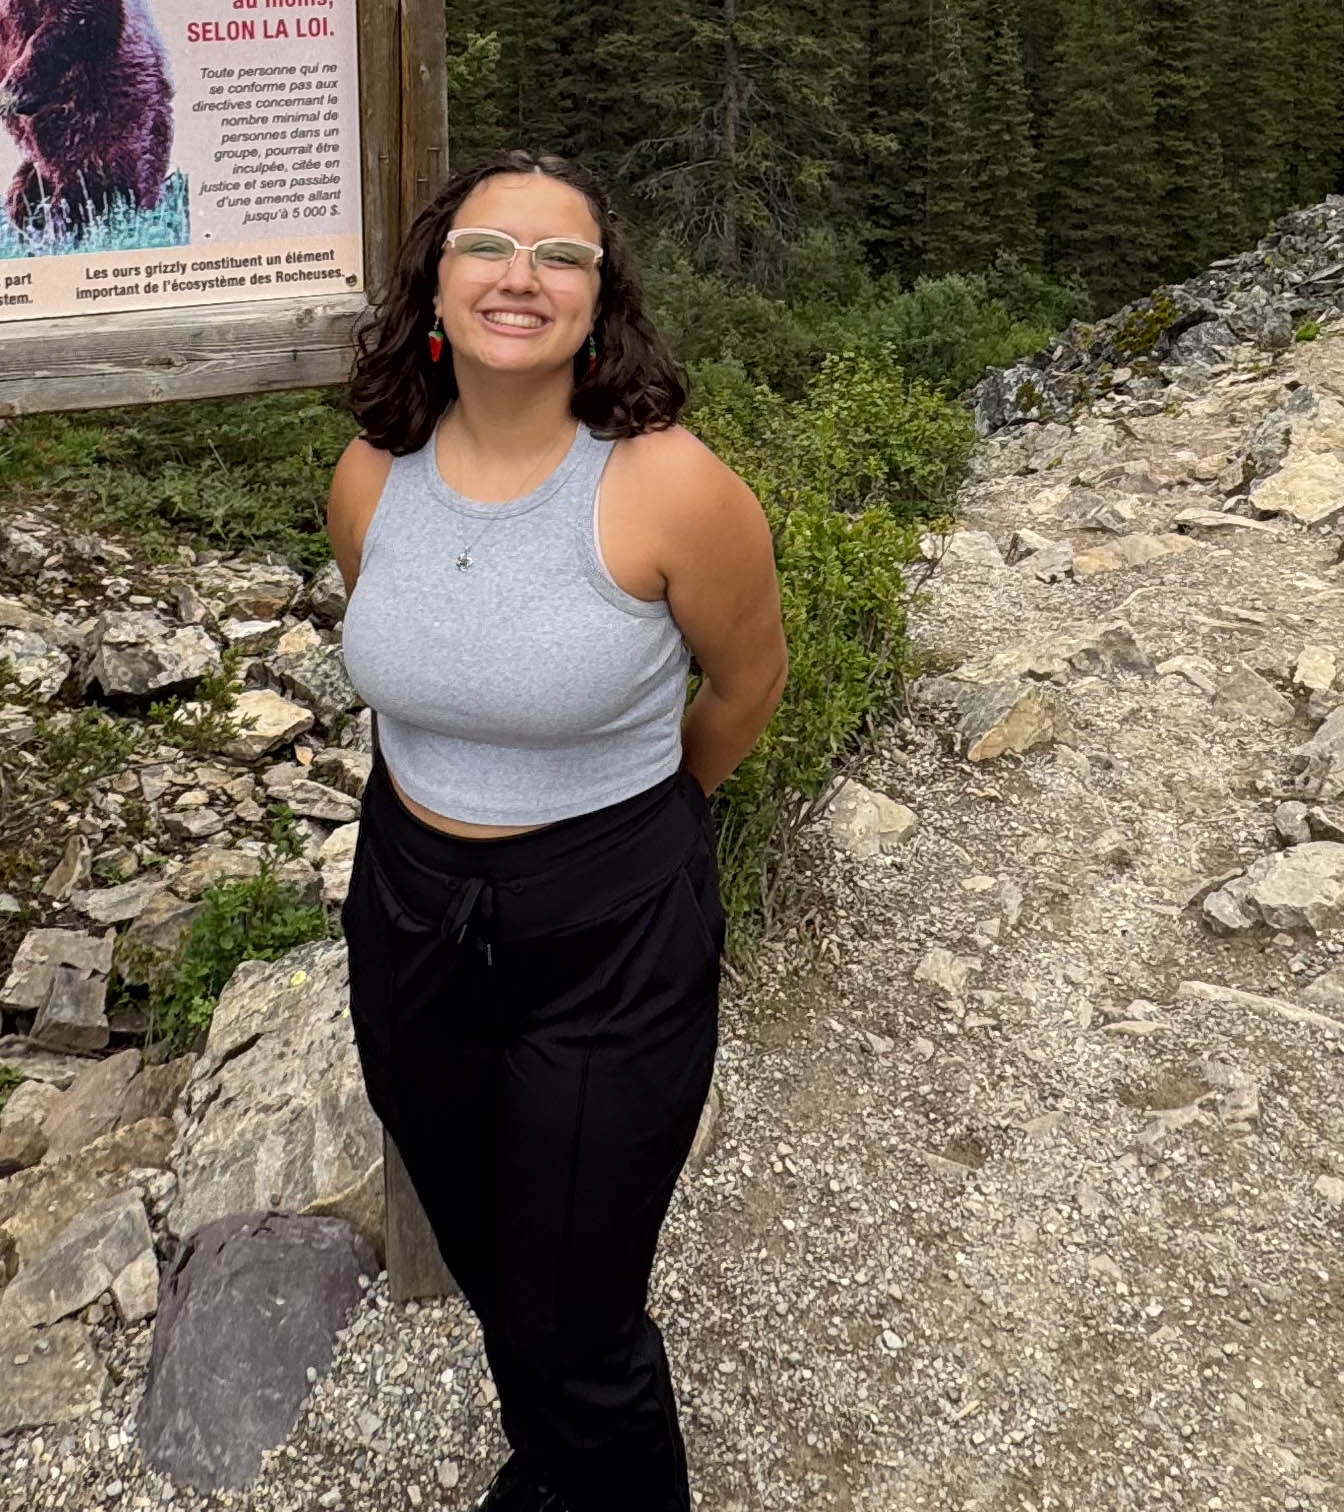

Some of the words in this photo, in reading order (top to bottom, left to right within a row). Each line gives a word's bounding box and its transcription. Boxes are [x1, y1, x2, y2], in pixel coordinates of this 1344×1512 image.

[187, 21, 255, 42] SELON
[263, 19, 289, 39] LA
[296, 17, 334, 37] LOI.
[86, 267, 108, 280] Les
[112, 264, 141, 278] ours
[145, 261, 187, 277] grizzly
[191, 255, 262, 272] constituent
[266, 255, 282, 266] un
[286, 249, 334, 264] élément
[6, 273, 32, 288] part
[76, 284, 140, 300] important
[144, 282, 159, 294] de
[163, 275, 246, 292] l'écosystème
[250, 273, 272, 285] des
[276, 267, 346, 282] Rocheuses.
